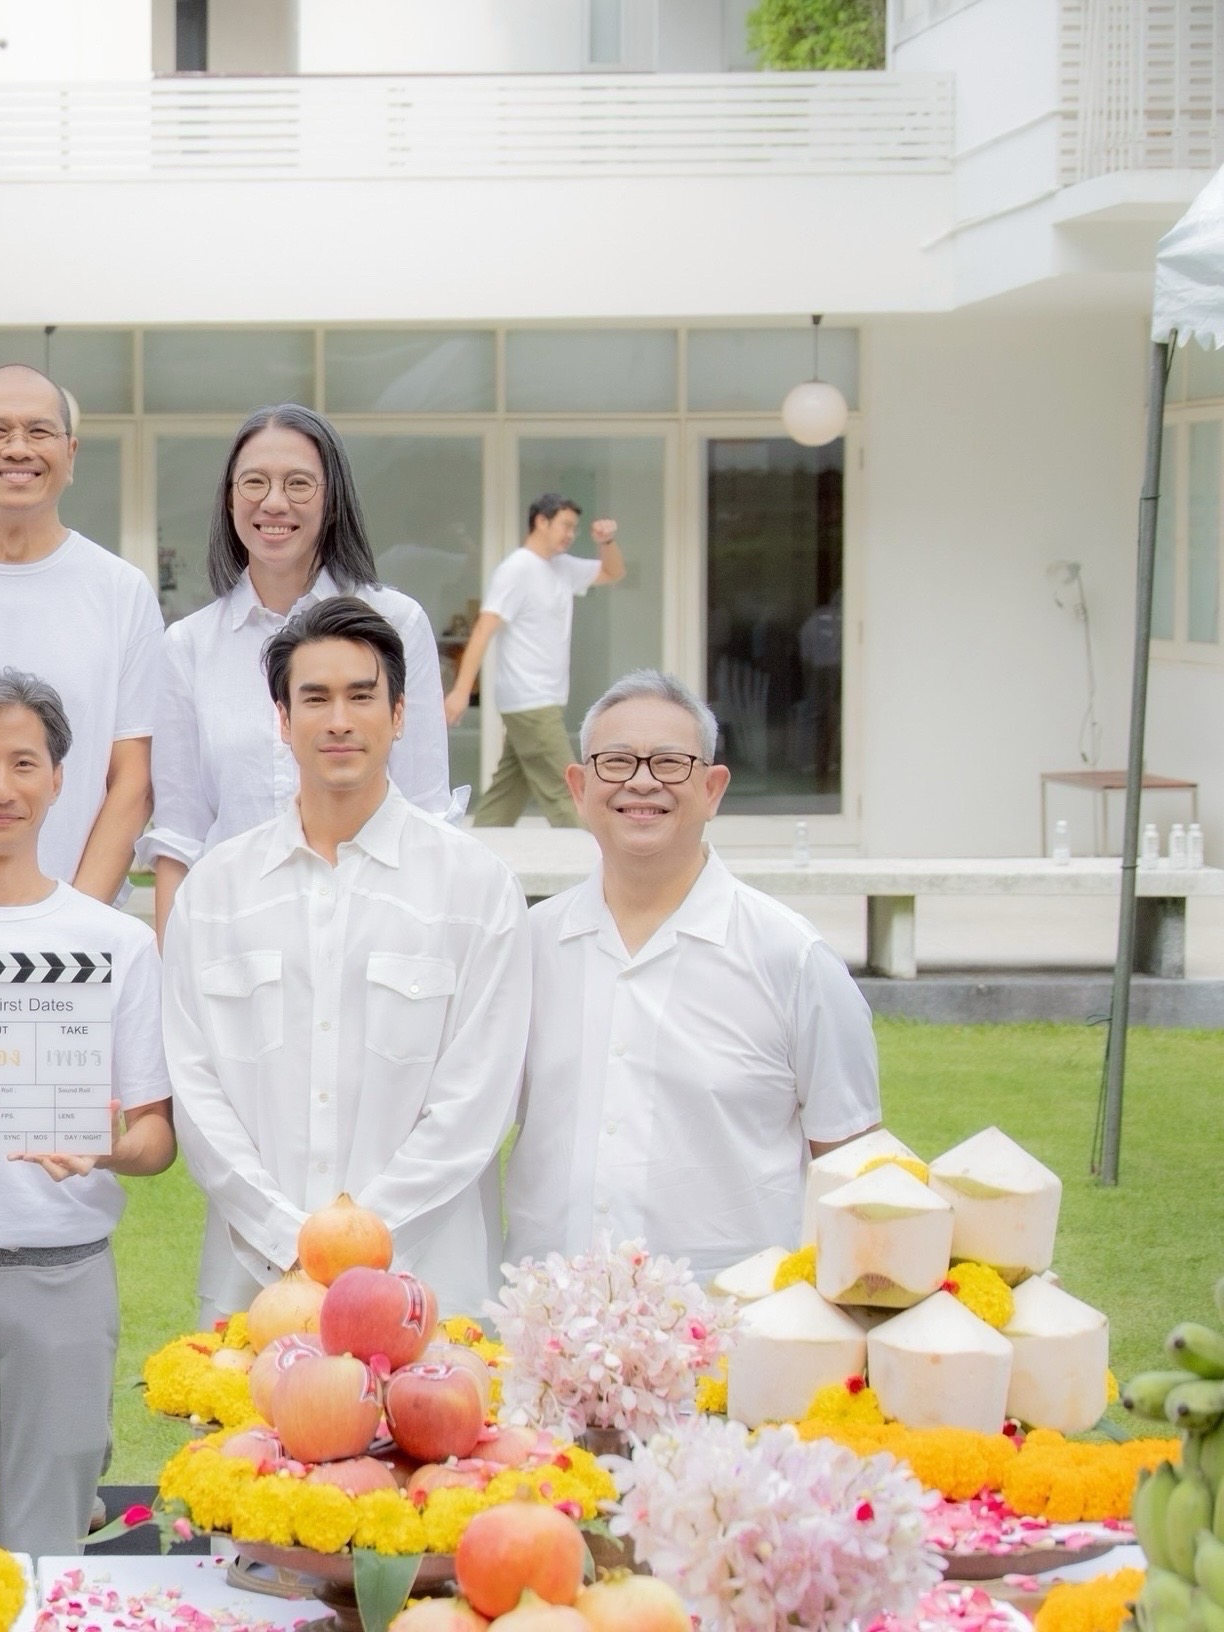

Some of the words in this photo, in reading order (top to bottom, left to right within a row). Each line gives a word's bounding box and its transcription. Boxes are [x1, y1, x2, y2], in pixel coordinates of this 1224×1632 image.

[28, 997, 74, 1012] Dates
[60, 1025, 89, 1035] TAKE
[46, 1048, 103, 1067] เพชร
[1, 1086, 14, 1094] Roll
[58, 1086, 78, 1094] Sound
[79, 1086, 91, 1094] Roll
